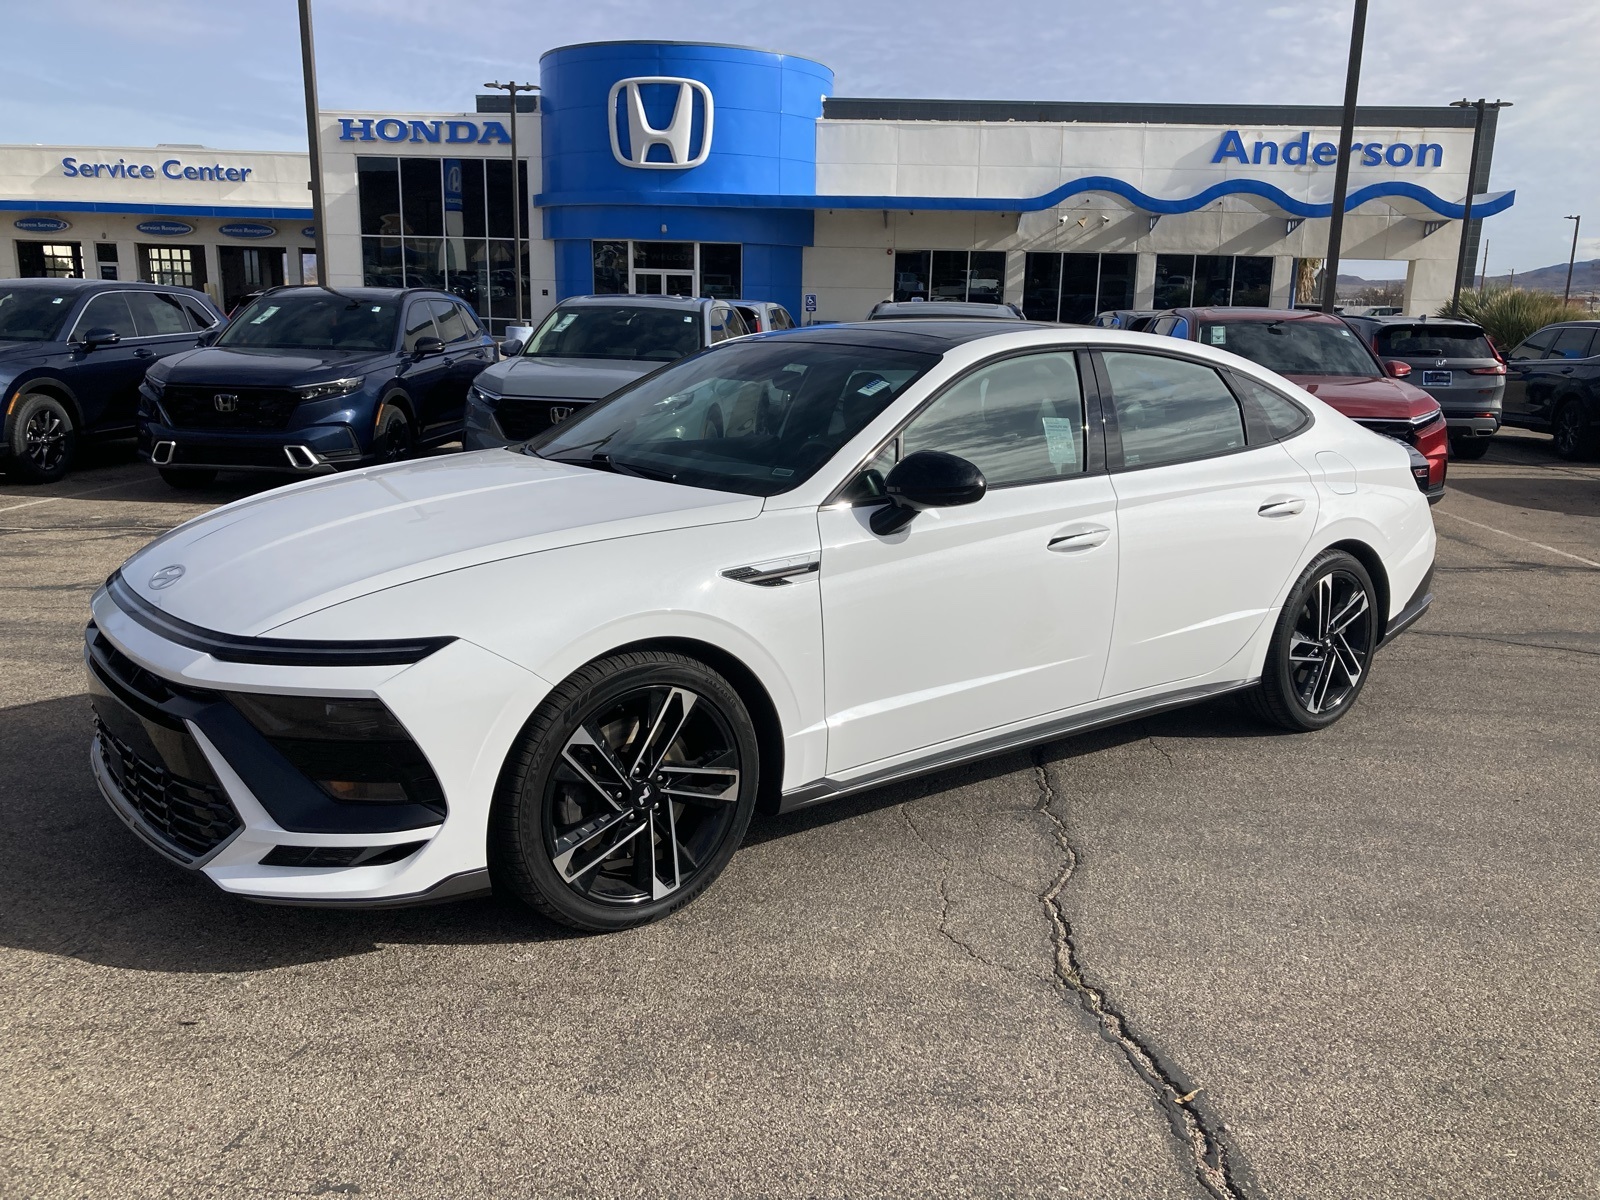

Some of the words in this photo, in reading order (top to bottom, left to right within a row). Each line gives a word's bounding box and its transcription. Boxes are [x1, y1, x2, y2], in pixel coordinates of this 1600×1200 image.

[338, 118, 512, 145] HONDA
[62, 157, 155, 179] Service
[162, 159, 252, 182] Center
[161, 225, 190, 233] Reception
[243, 228, 272, 236] Reception
